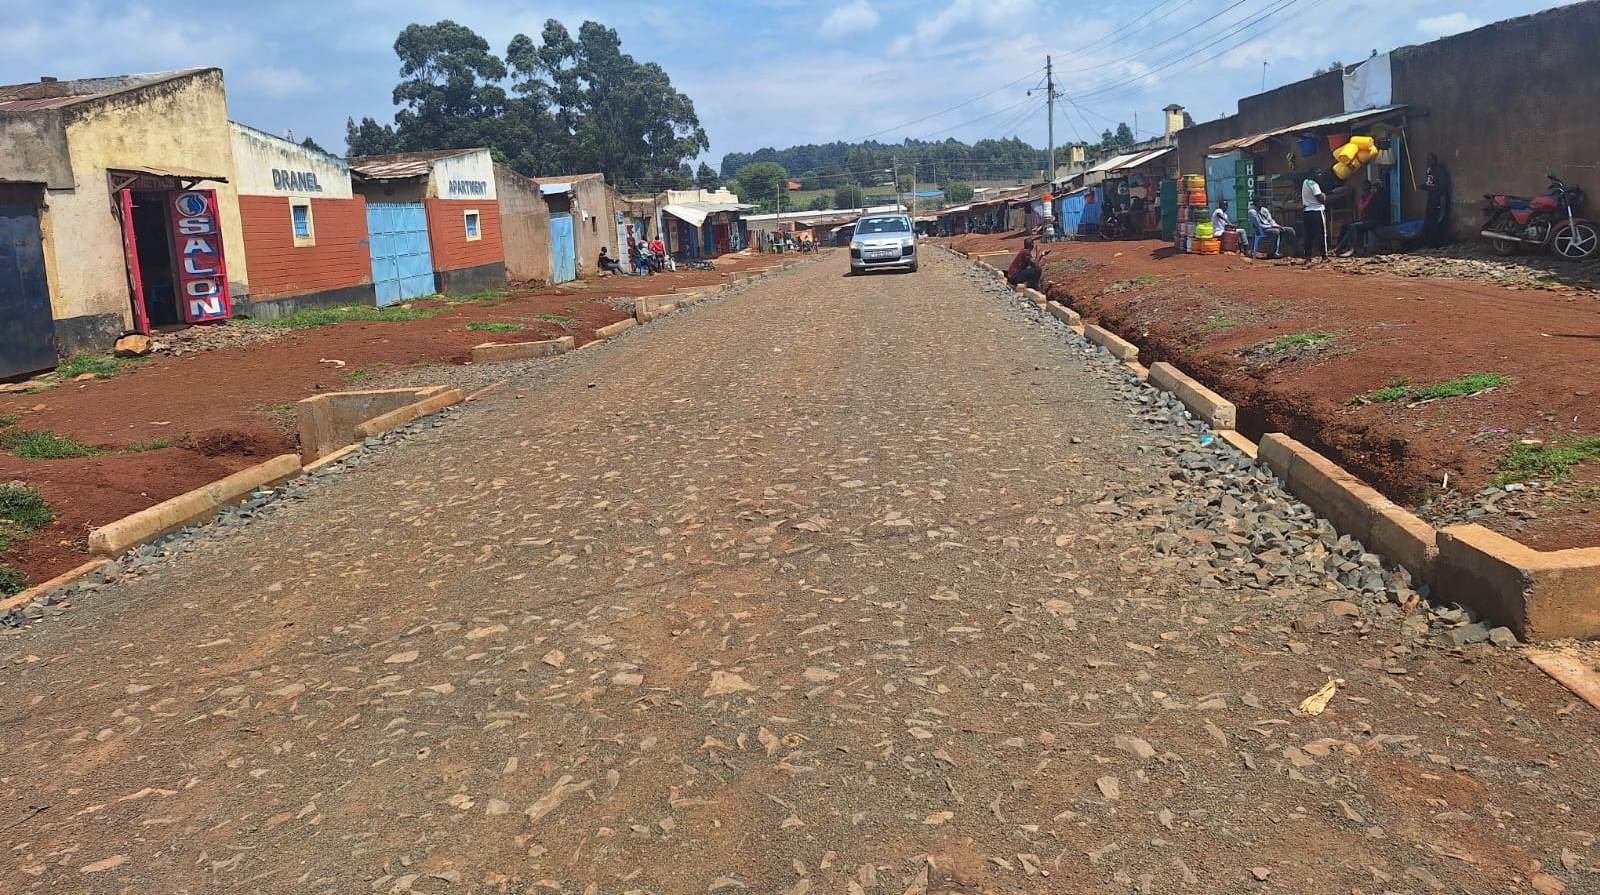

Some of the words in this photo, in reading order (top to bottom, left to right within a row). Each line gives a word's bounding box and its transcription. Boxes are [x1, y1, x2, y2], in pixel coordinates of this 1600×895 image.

[272, 169, 323, 192] DRANEL
[448, 180, 487, 196] APARTMENT
[1246, 164, 1255, 209] HOTE
[179, 218, 224, 317] SALON
